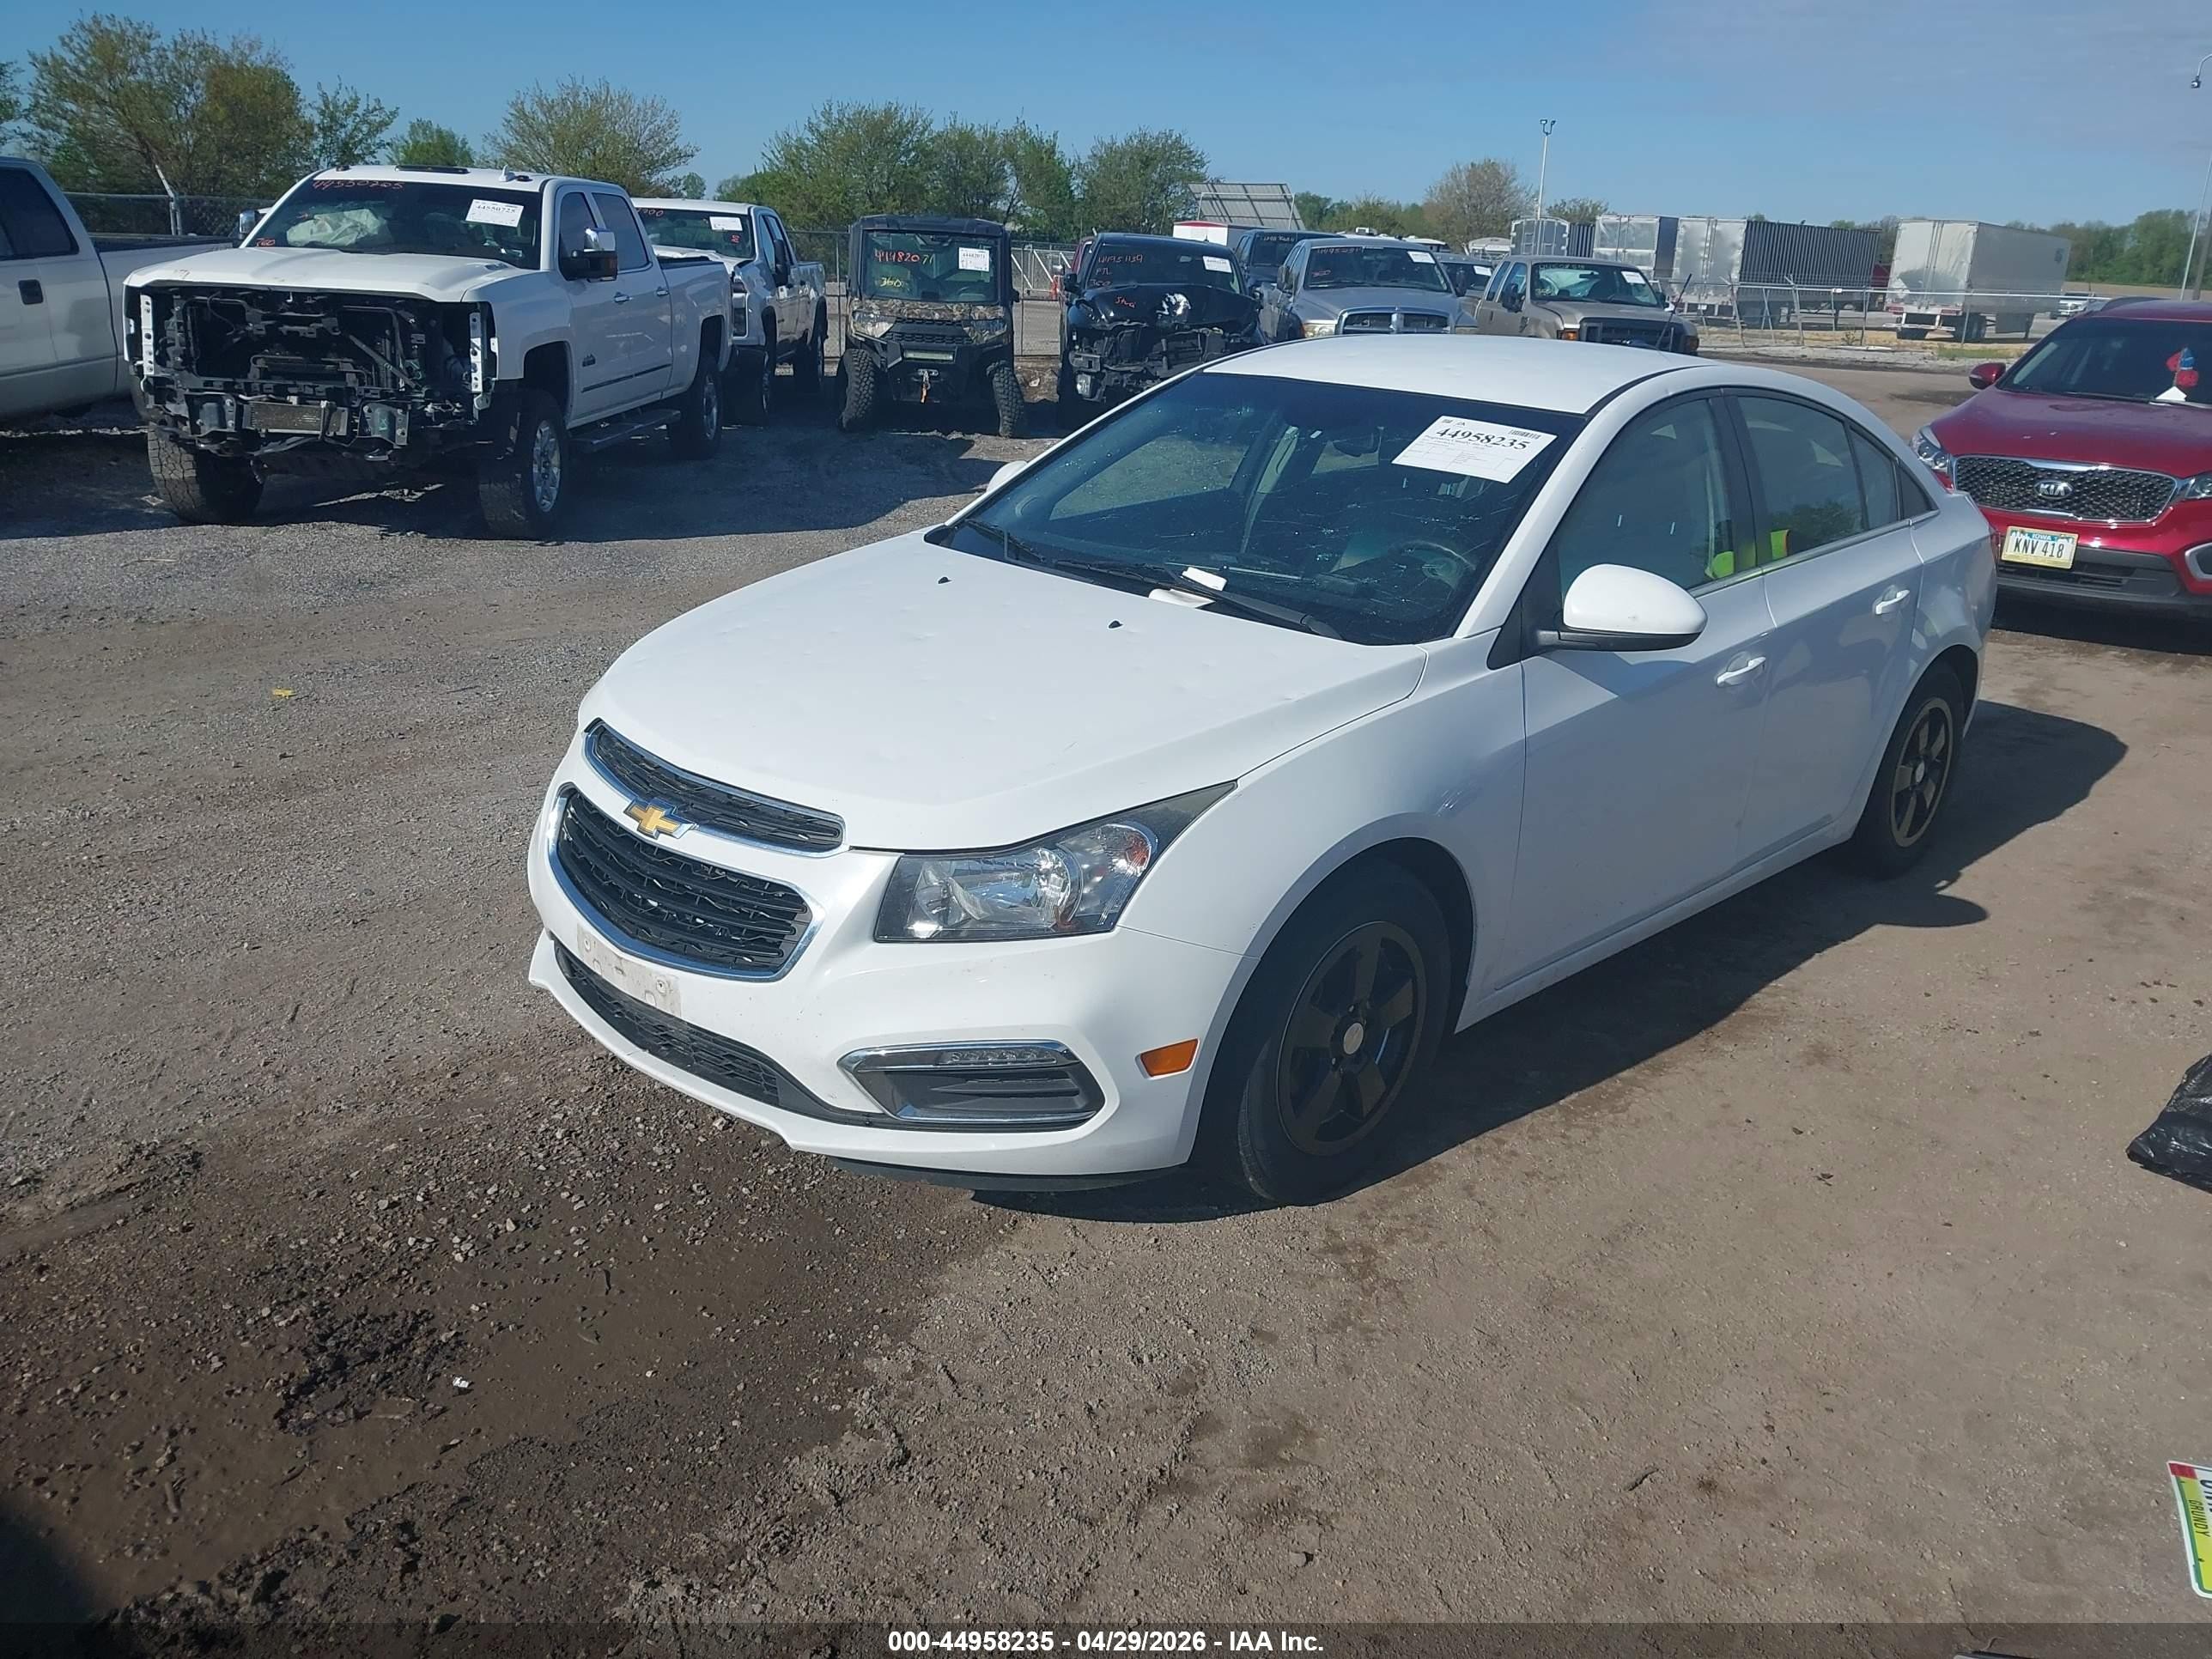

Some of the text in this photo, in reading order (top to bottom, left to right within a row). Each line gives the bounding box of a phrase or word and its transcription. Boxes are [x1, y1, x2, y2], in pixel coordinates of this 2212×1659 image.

[1435, 428, 1531, 450] 44958235
[2039, 483, 2066, 496] KIA
[2032, 532, 2052, 541] IOWA
[2013, 537, 2065, 558] KNV 418
[2188, 1499, 2211, 1538] GRUNDY
